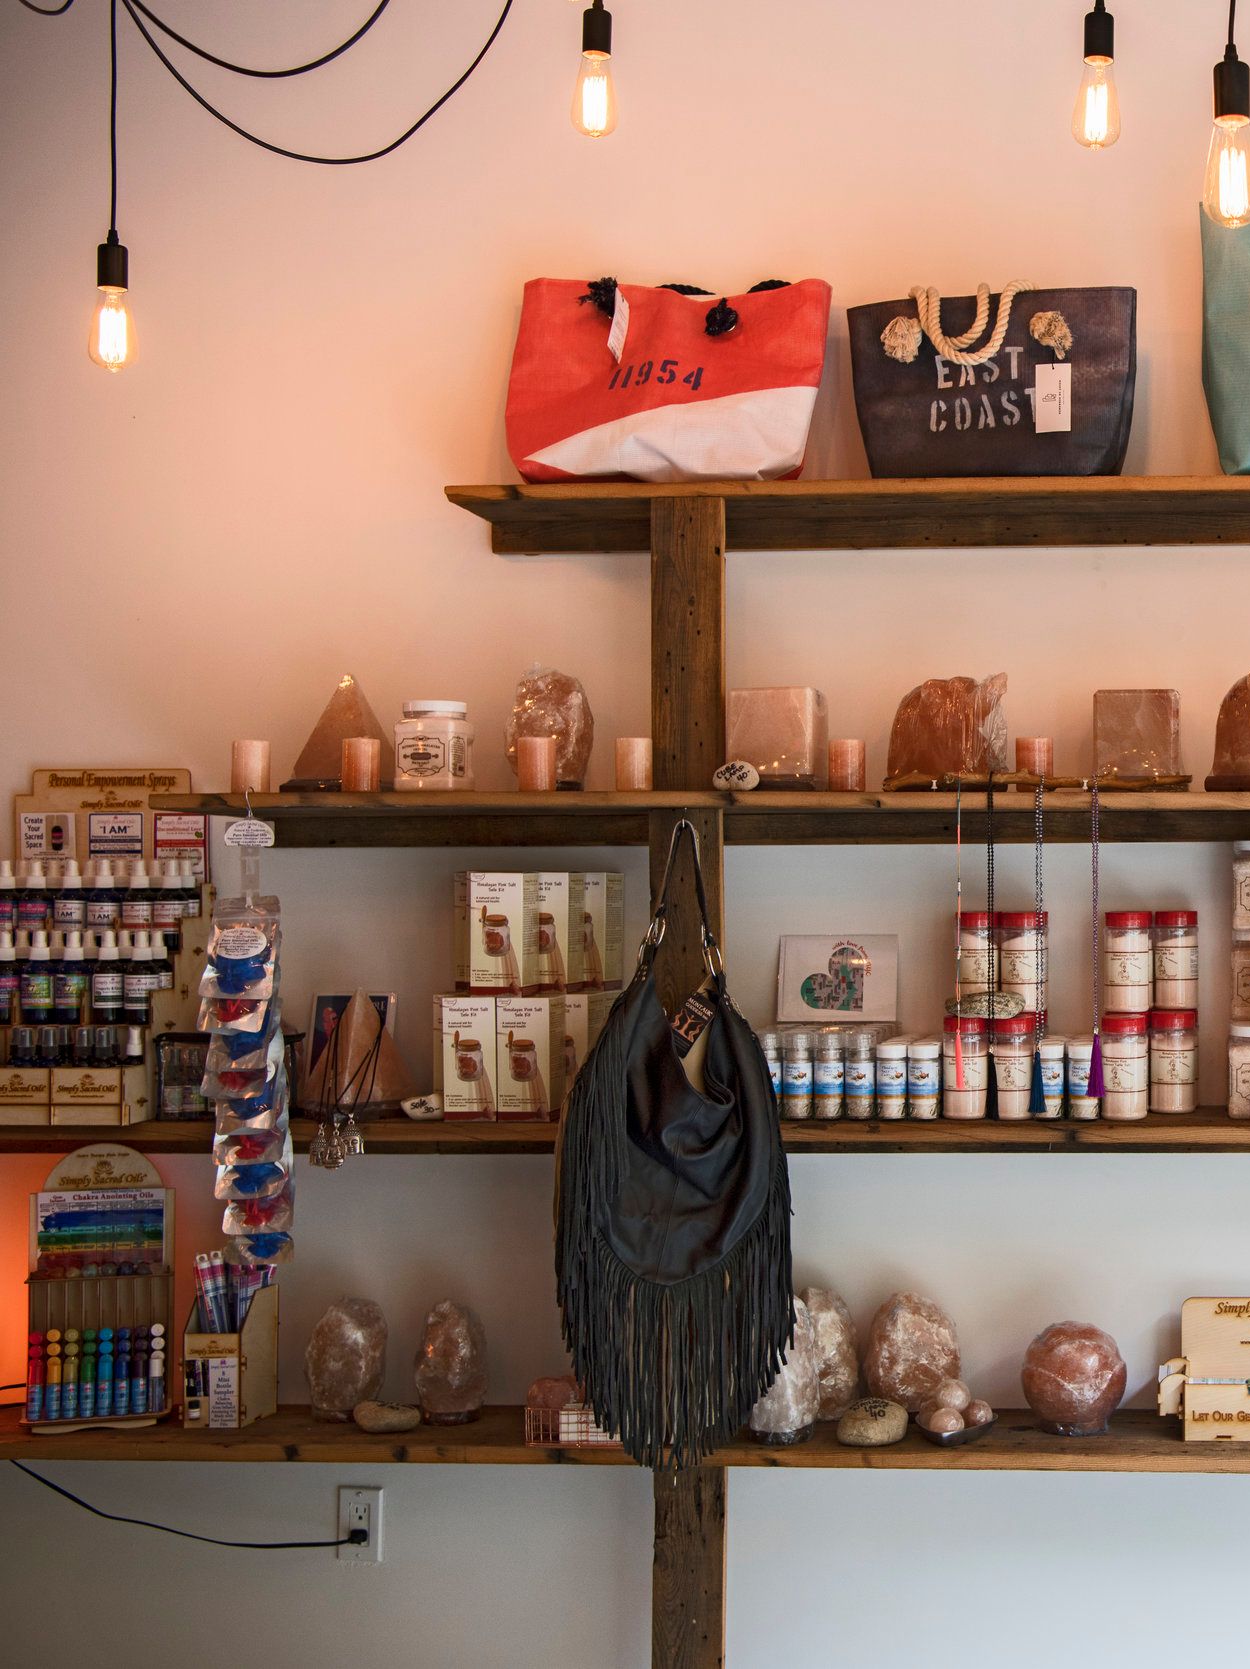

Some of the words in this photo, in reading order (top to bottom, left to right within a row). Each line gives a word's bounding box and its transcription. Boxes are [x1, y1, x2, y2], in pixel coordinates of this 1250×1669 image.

[934, 346, 1024, 389] EAST
[49, 772, 85, 788] Personal
[86, 773, 146, 792] Empowerment
[147, 773, 177, 791] Sprays
[23, 816, 43, 824] Create
[24, 833, 44, 841] Sacred
[59, 1175, 92, 1187] Simply
[93, 1173, 124, 1185] Sacred
[100, 1193, 137, 1201] Anointing
[1192, 1411, 1208, 1423] LET
[1212, 1411, 1233, 1423] OUR
